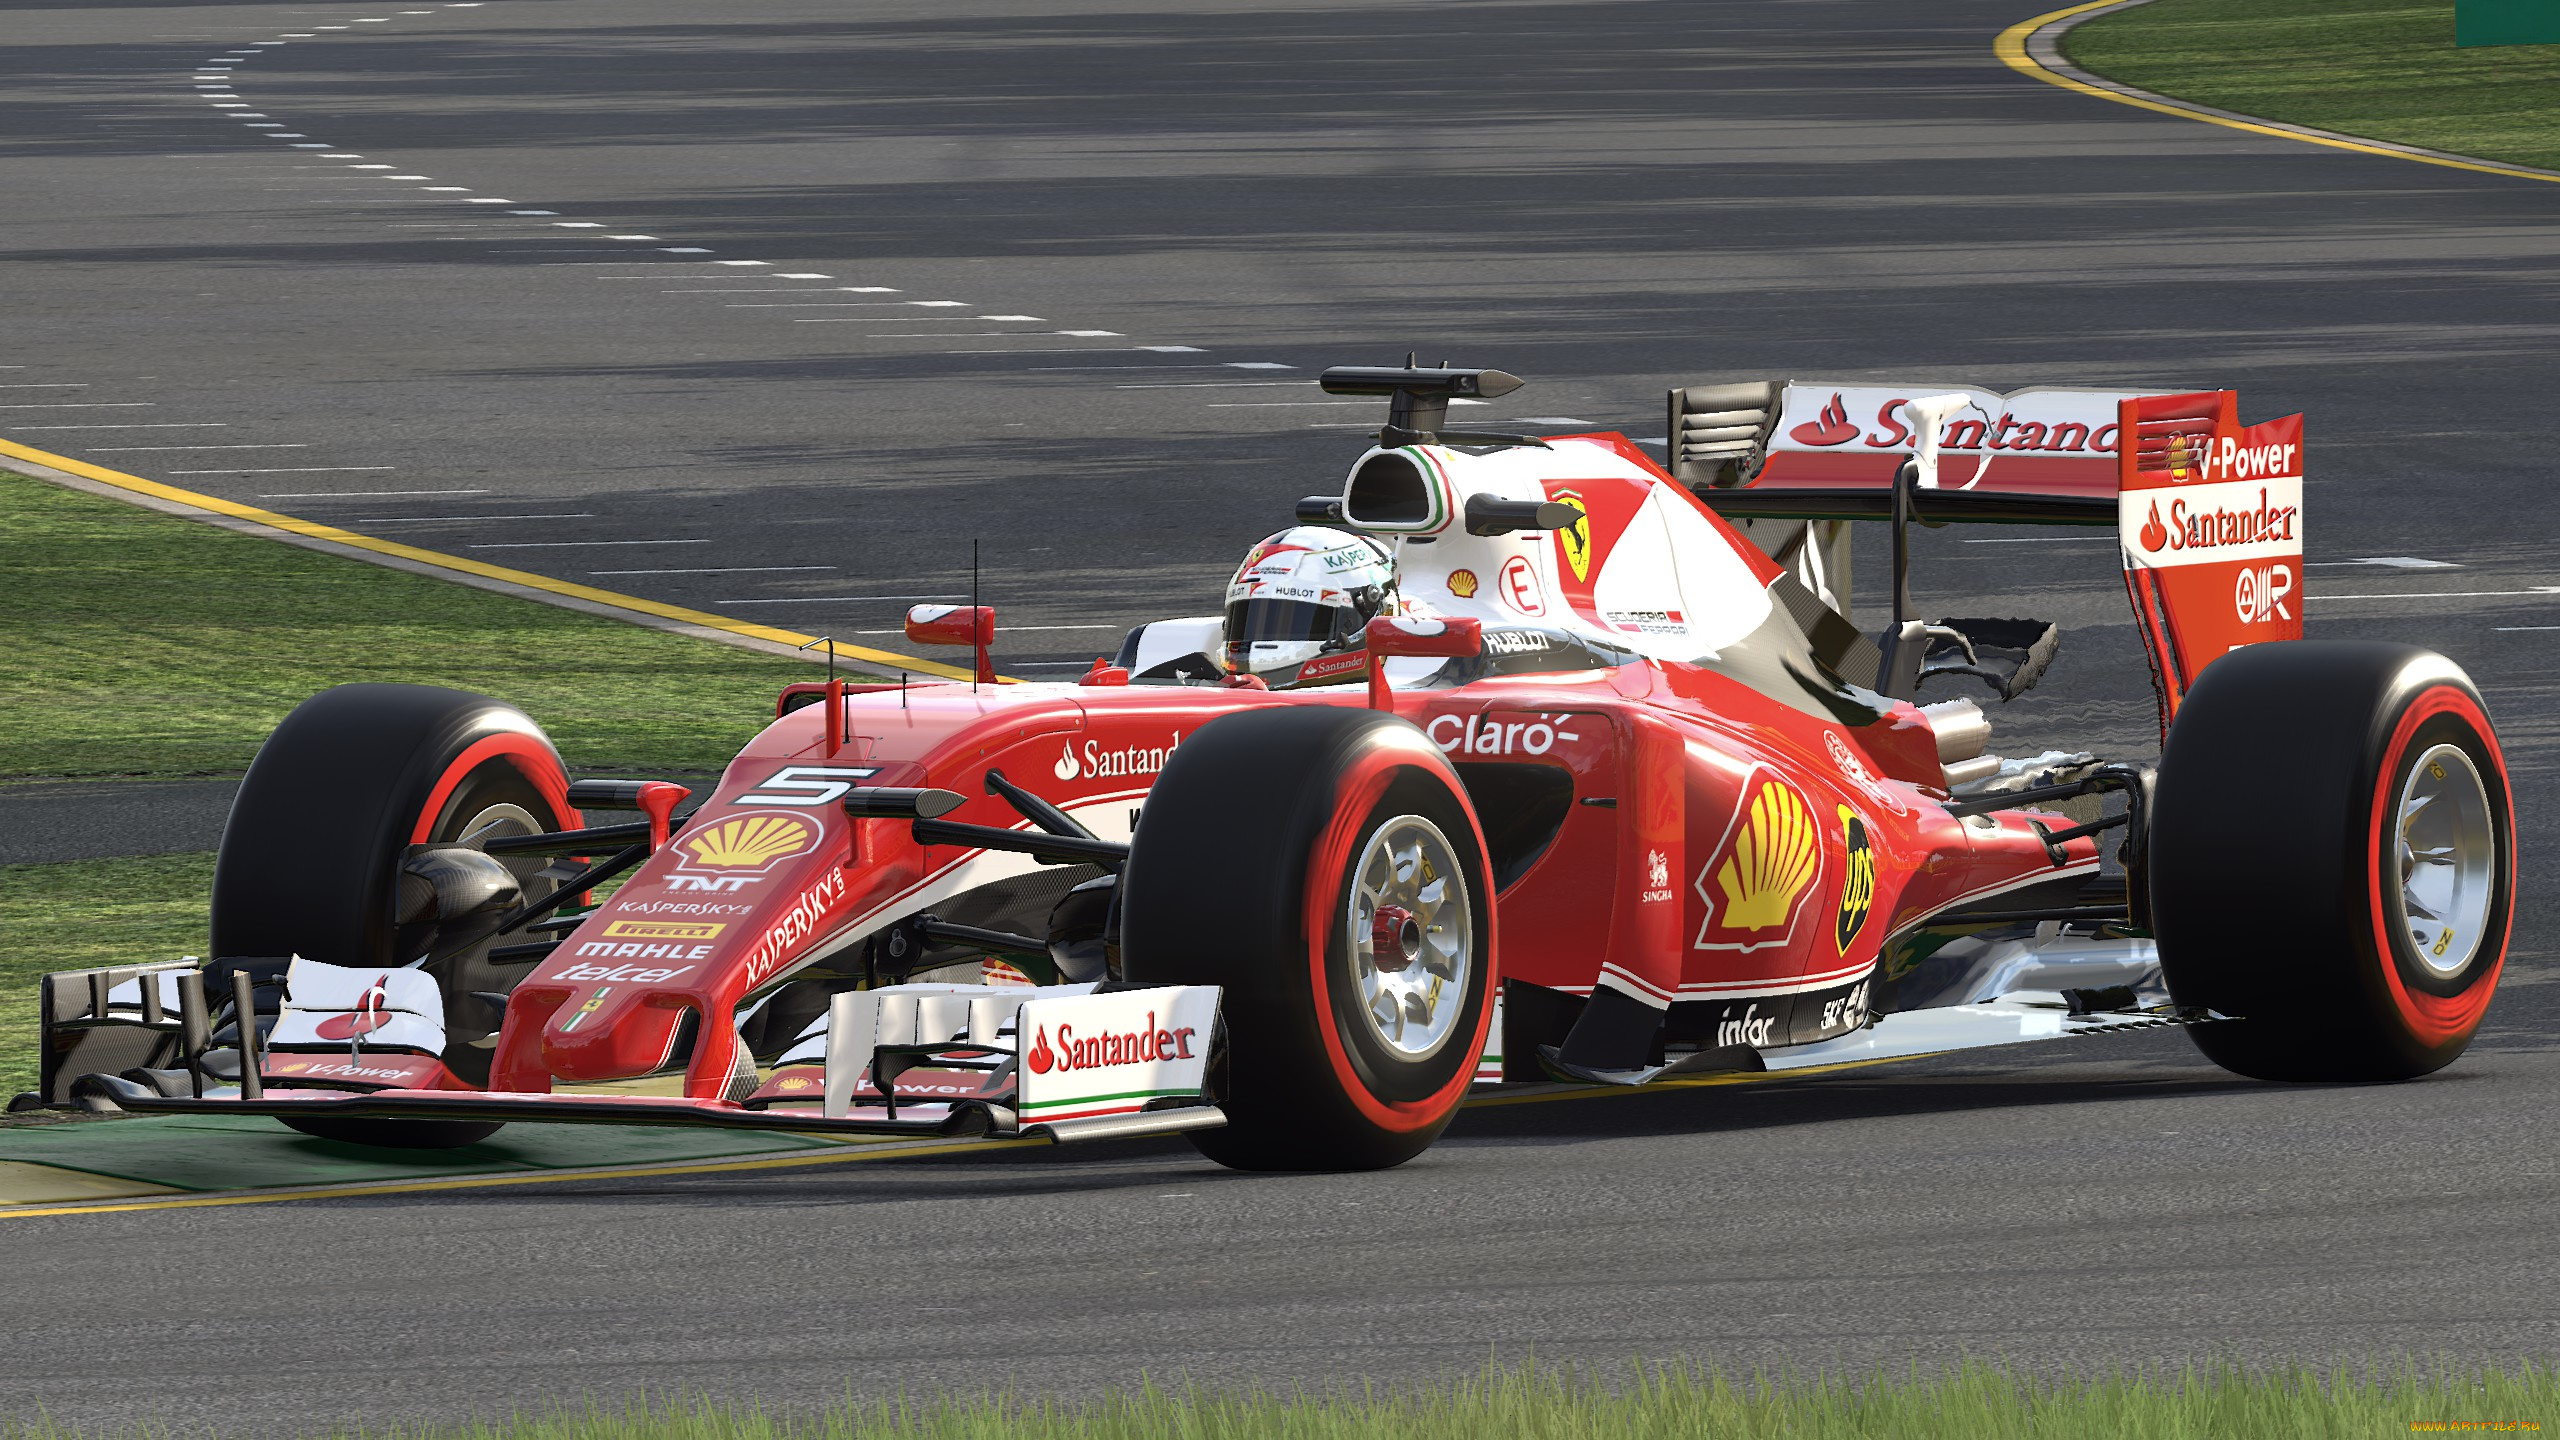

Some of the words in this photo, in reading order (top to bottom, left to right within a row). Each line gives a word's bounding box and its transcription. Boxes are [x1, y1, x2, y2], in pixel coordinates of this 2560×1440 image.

[1864, 399, 2118, 452] Sntan
[2171, 486, 2297, 550] Santander
[1276, 587, 1315, 598] HUBLOT
[1606, 611, 1668, 622] SCUDERIA
[1481, 630, 1550, 654] HUBLOT
[1318, 656, 1363, 673] Santander
[729, 765, 884, 806] 5
[662, 874, 765, 891] TNT
[617, 900, 742, 916] KASPERSKY
[616, 924, 714, 937] PIRELLI
[745, 872, 834, 990] KASPERSKY
[575, 941, 714, 959] MAHLE
[551, 962, 696, 983] telcel
[1820, 997, 1846, 1030] SKF
[1718, 1003, 1775, 1047] infor
[1057, 1010, 1196, 1072] Santander
[306, 1063, 413, 1079] V-Power
